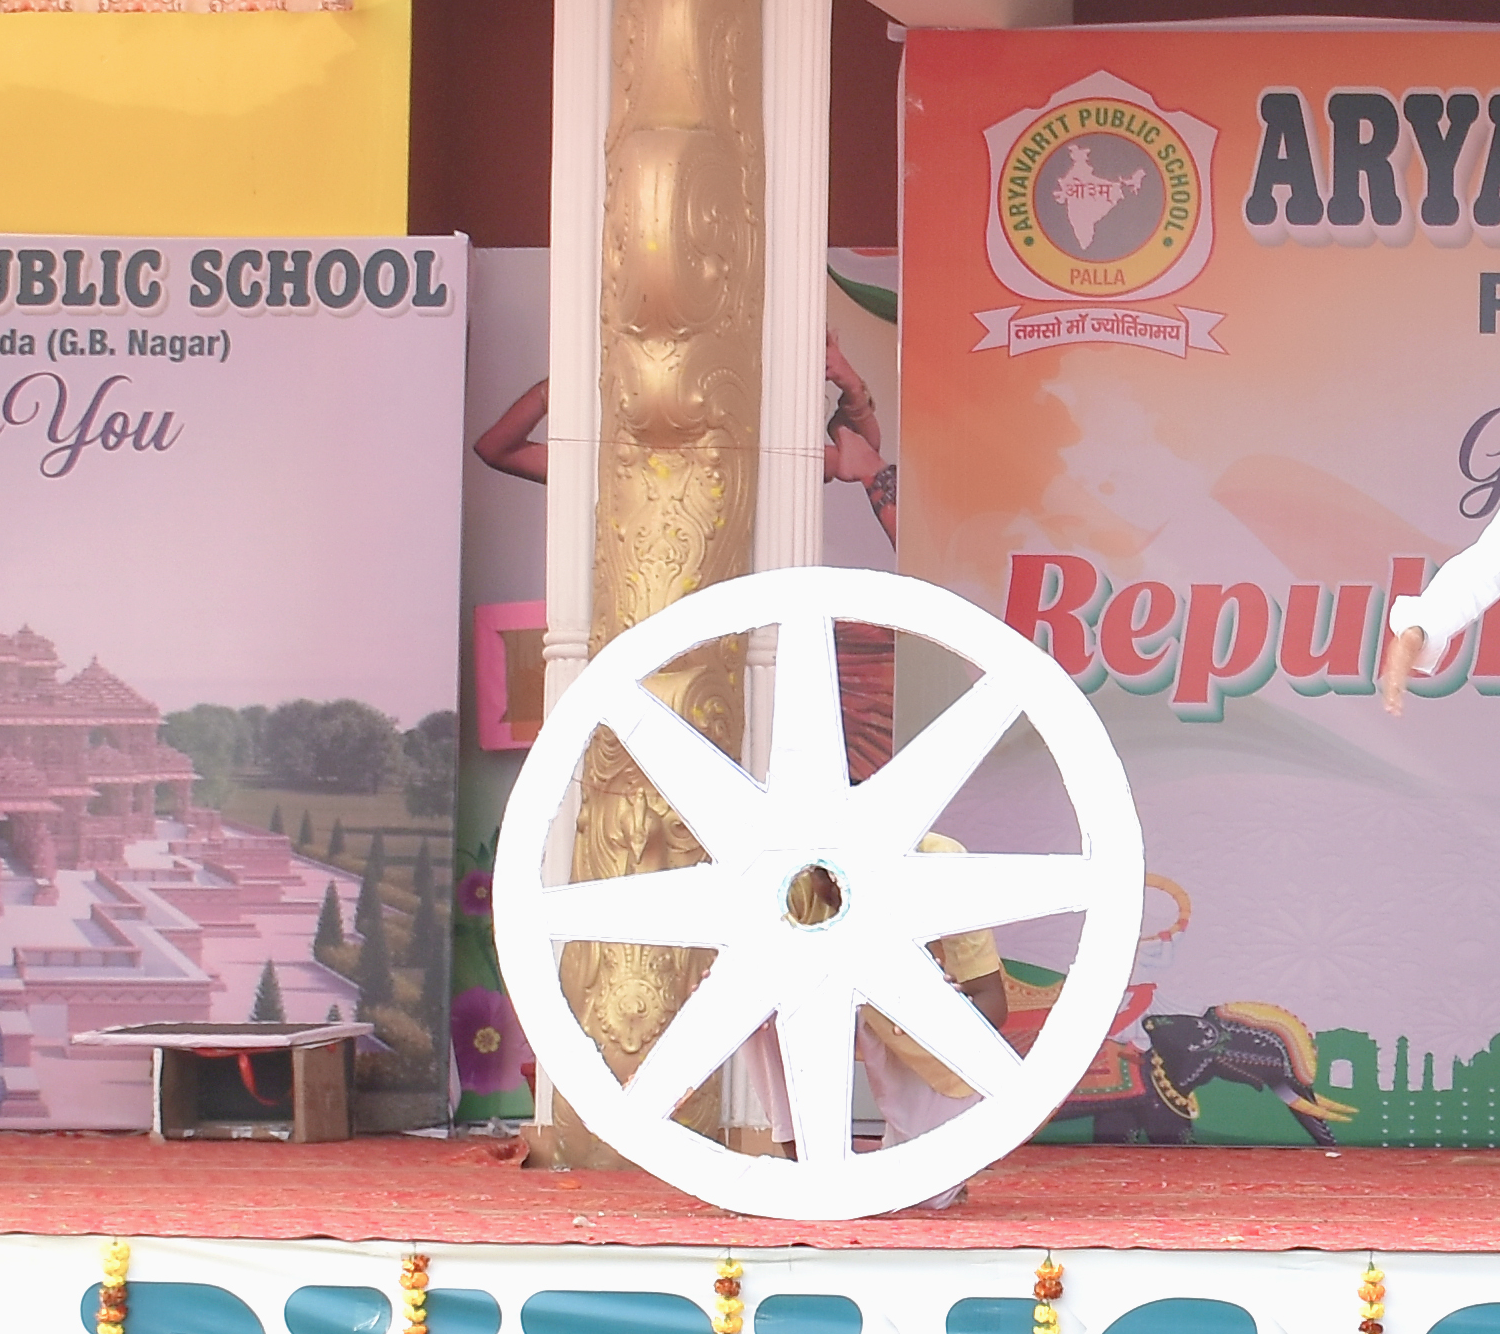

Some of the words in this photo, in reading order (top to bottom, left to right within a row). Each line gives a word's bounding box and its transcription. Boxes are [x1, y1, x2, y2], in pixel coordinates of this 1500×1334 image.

[1008, 113, 1071, 232] ARYAVARTT
[1078, 107, 1160, 145] PUBLIC
[1157, 143, 1191, 232] SCHOOL
[189, 248, 448, 309] SCHOOL
[1069, 267, 1126, 286] PALLA
[47, 327, 116, 362] (G.B.
[127, 328, 232, 363] Nagar)
[1014, 315, 1061, 341] तमसो
[1, 371, 185, 479] You
